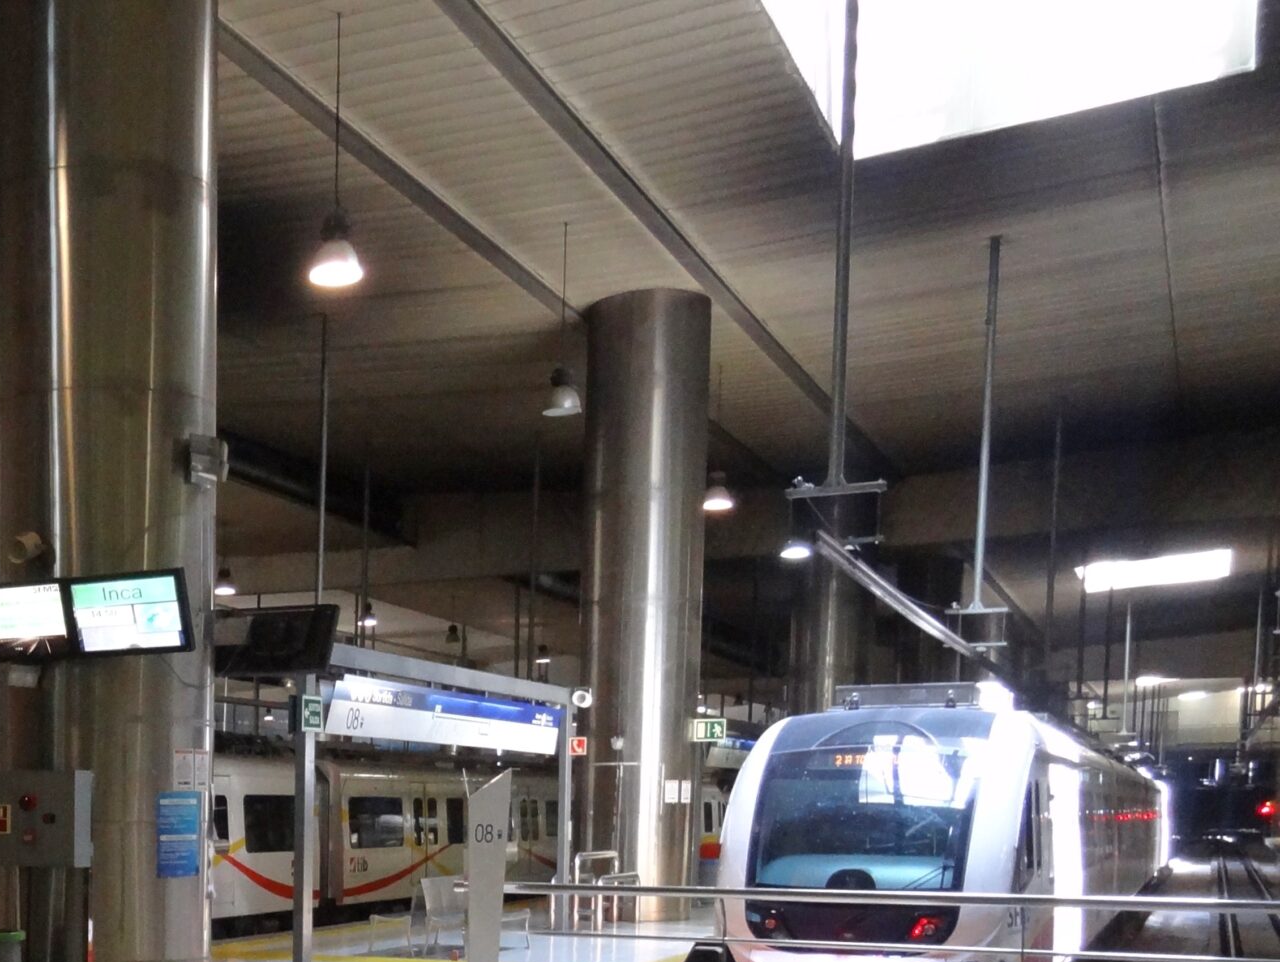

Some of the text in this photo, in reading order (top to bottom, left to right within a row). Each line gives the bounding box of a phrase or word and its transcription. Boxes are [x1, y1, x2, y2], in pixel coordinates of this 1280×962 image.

[101, 587, 143, 601] Inca
[346, 707, 361, 730] 08
[474, 824, 494, 842] 08
